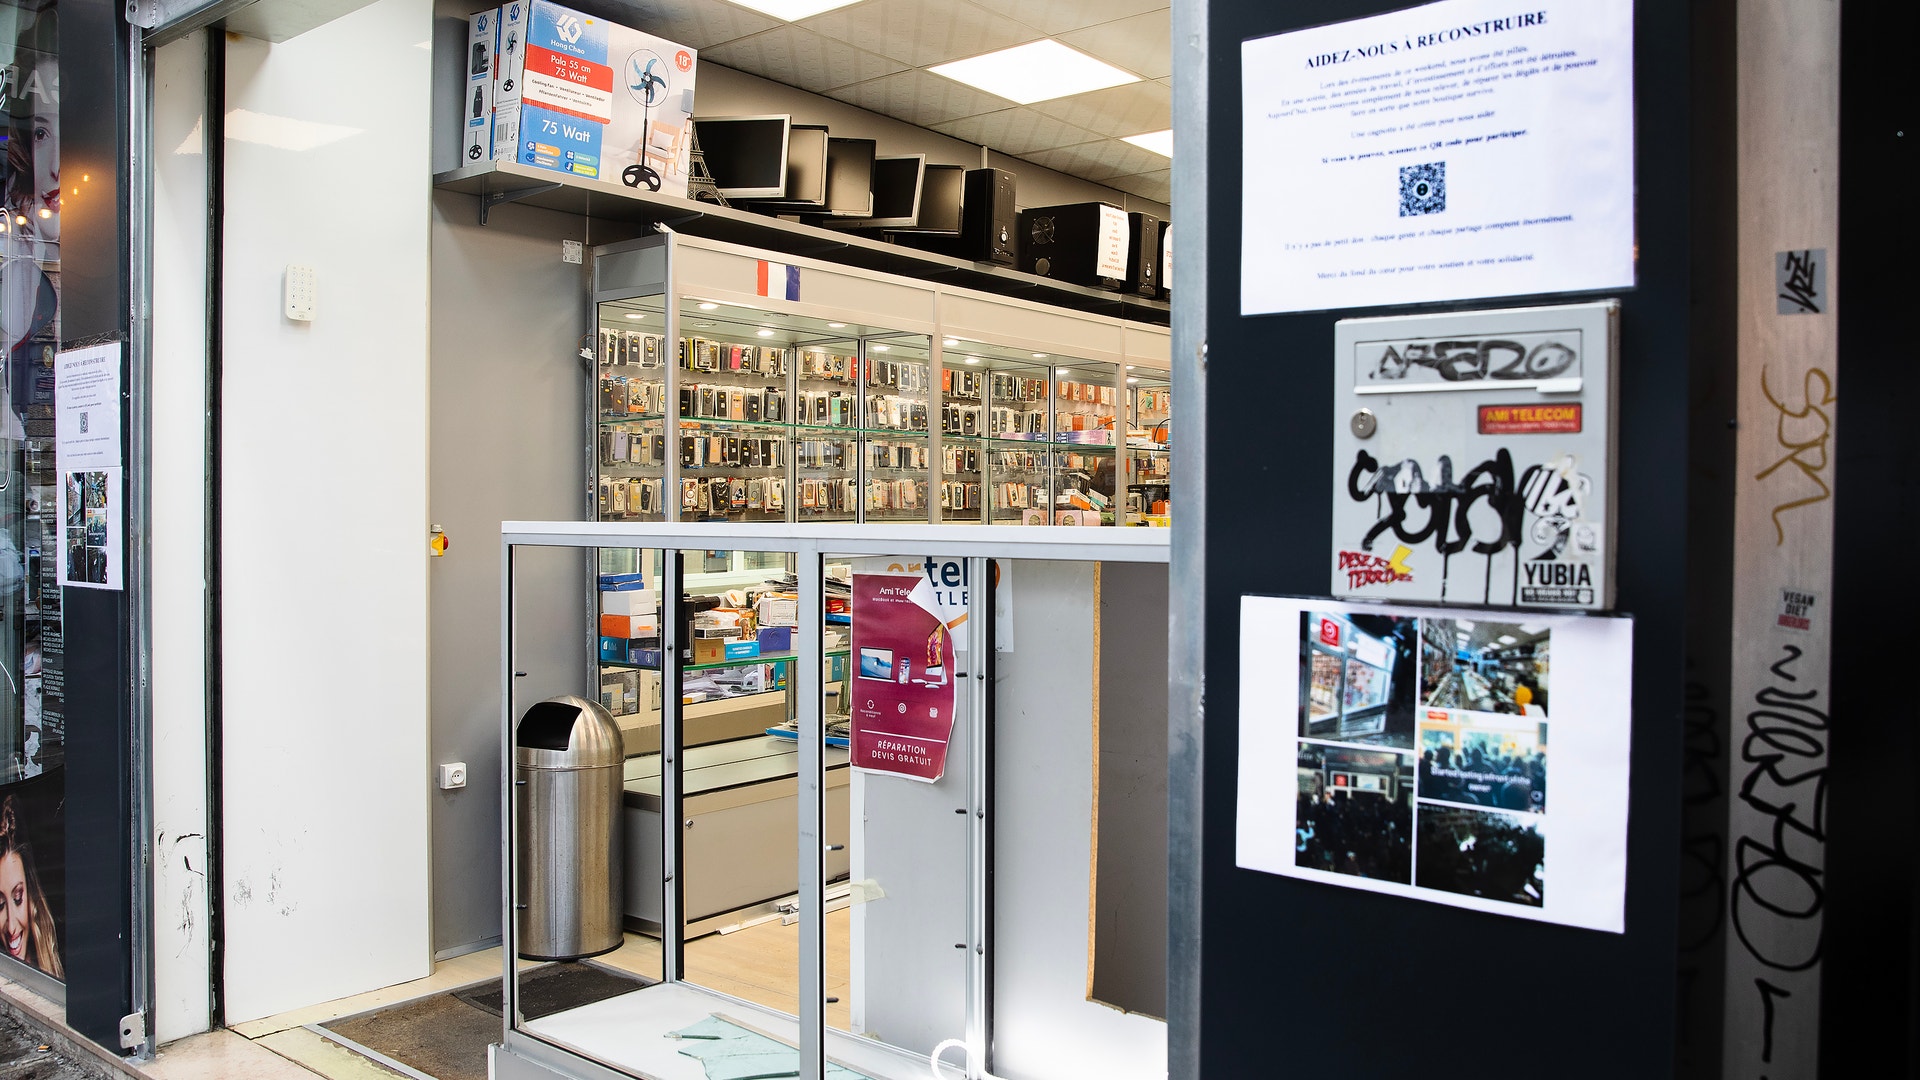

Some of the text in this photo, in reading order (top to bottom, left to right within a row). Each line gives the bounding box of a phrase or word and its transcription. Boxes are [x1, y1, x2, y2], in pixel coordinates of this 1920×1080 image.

[1305, 44, 1397, 67] AIDEZ-NOUS
[1417, 11, 1548, 47] RECONSTRUIRE
[551, 40, 585, 55] Hong Chao
[551, 54, 591, 74] Pala 55 cm
[555, 66, 587, 84] 75 Watt
[542, 120, 591, 143] 75 Watt
[1429, 141, 1441, 150] QR
[1465, 136, 1482, 145] pour
[1512, 408, 1575, 421] TELECOM
[1524, 563, 1592, 586] YUBIA
[880, 587, 894, 595] Ami
[1783, 590, 1814, 606] VEGAN
[1786, 603, 1807, 617] DIET
[878, 740, 926, 755] RÉPARATION
[872, 750, 931, 766] DEVIS GRATUIT
